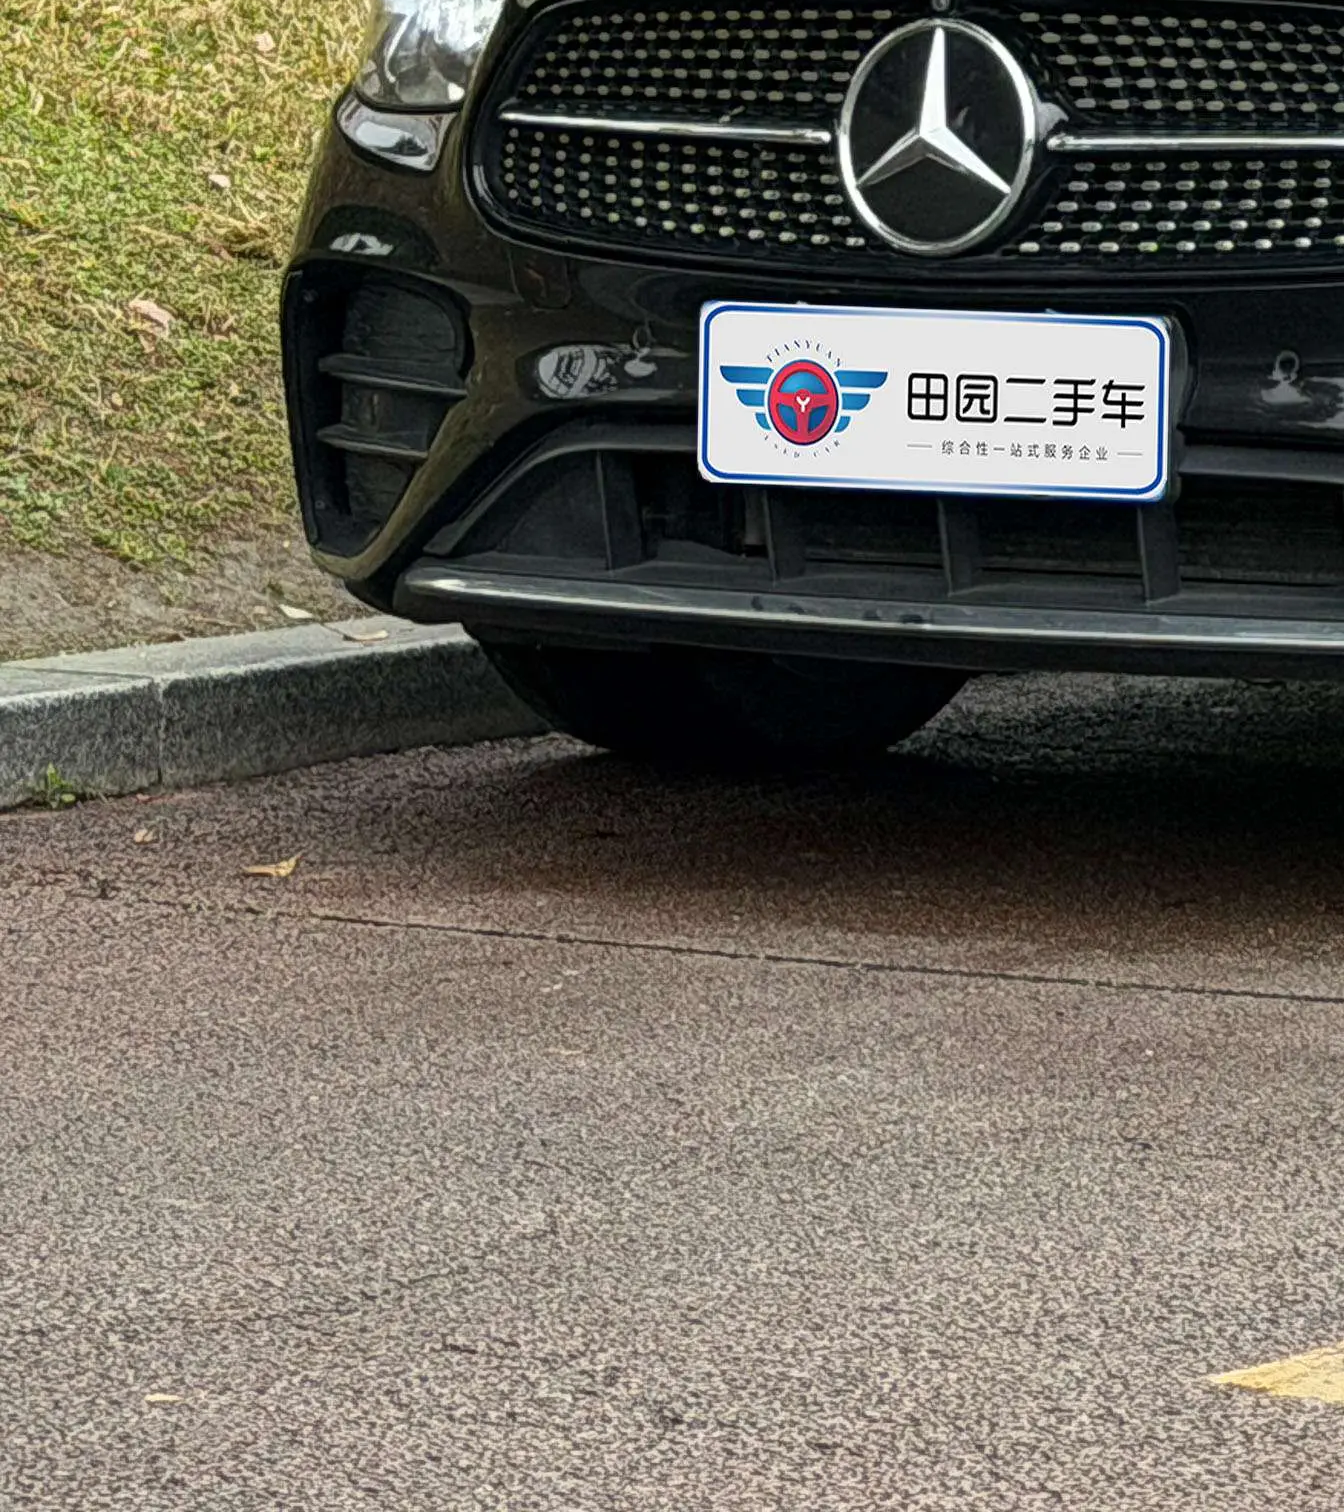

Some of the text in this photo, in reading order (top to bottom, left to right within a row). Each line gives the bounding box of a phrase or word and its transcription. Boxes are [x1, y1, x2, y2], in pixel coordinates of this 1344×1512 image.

[907, 372, 1146, 429] 田园二手车
[941, 439, 1109, 462] 综合性一站式服务企业
